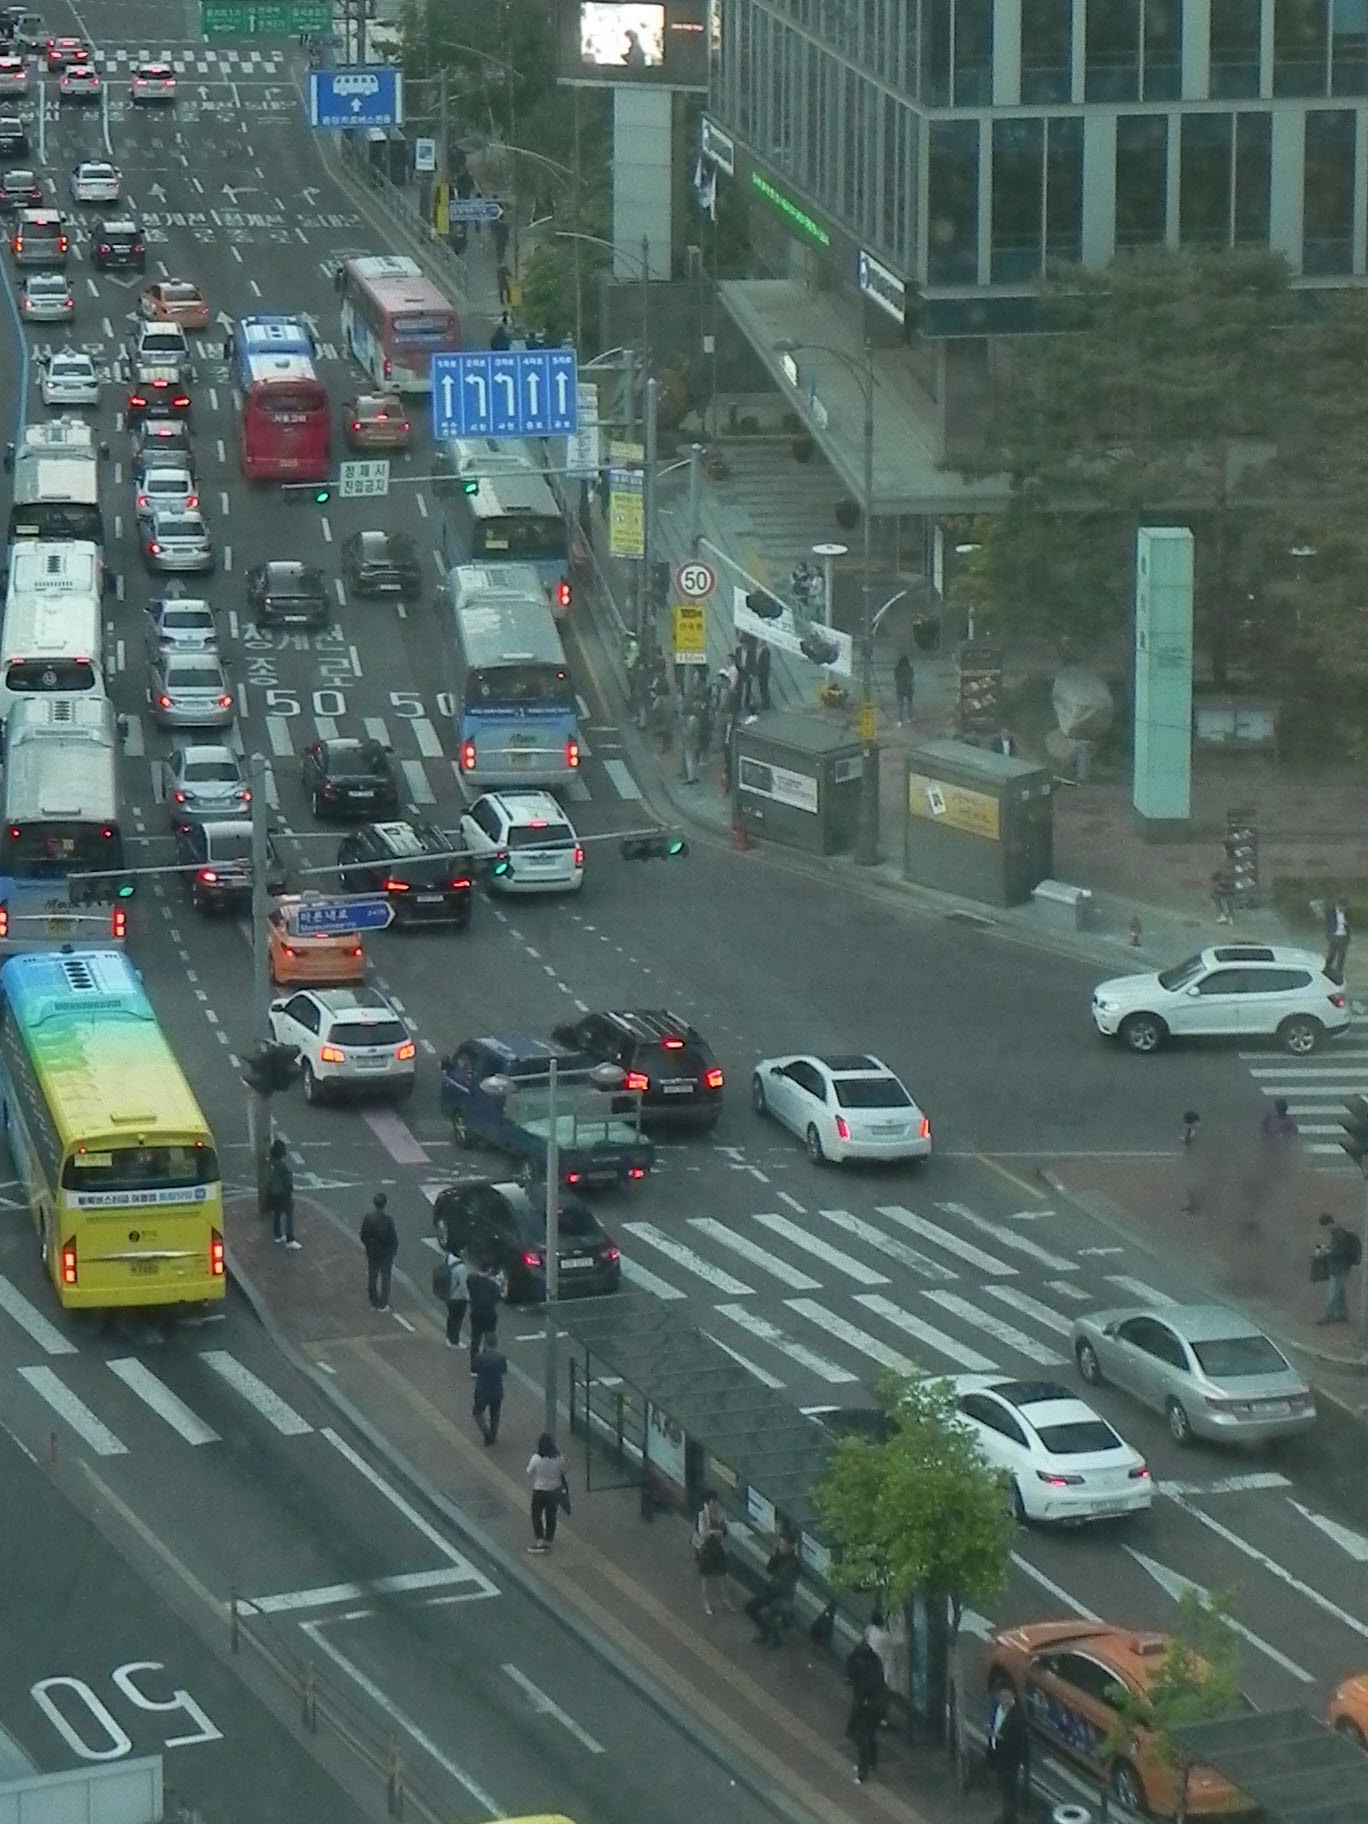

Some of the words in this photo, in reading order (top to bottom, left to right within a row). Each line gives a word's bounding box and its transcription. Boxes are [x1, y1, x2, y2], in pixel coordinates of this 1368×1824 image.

[345, 479, 385, 495] 진입금지
[684, 571, 707, 591] 50
[266, 690, 348, 717] 50
[31, 1661, 224, 1761] 50
